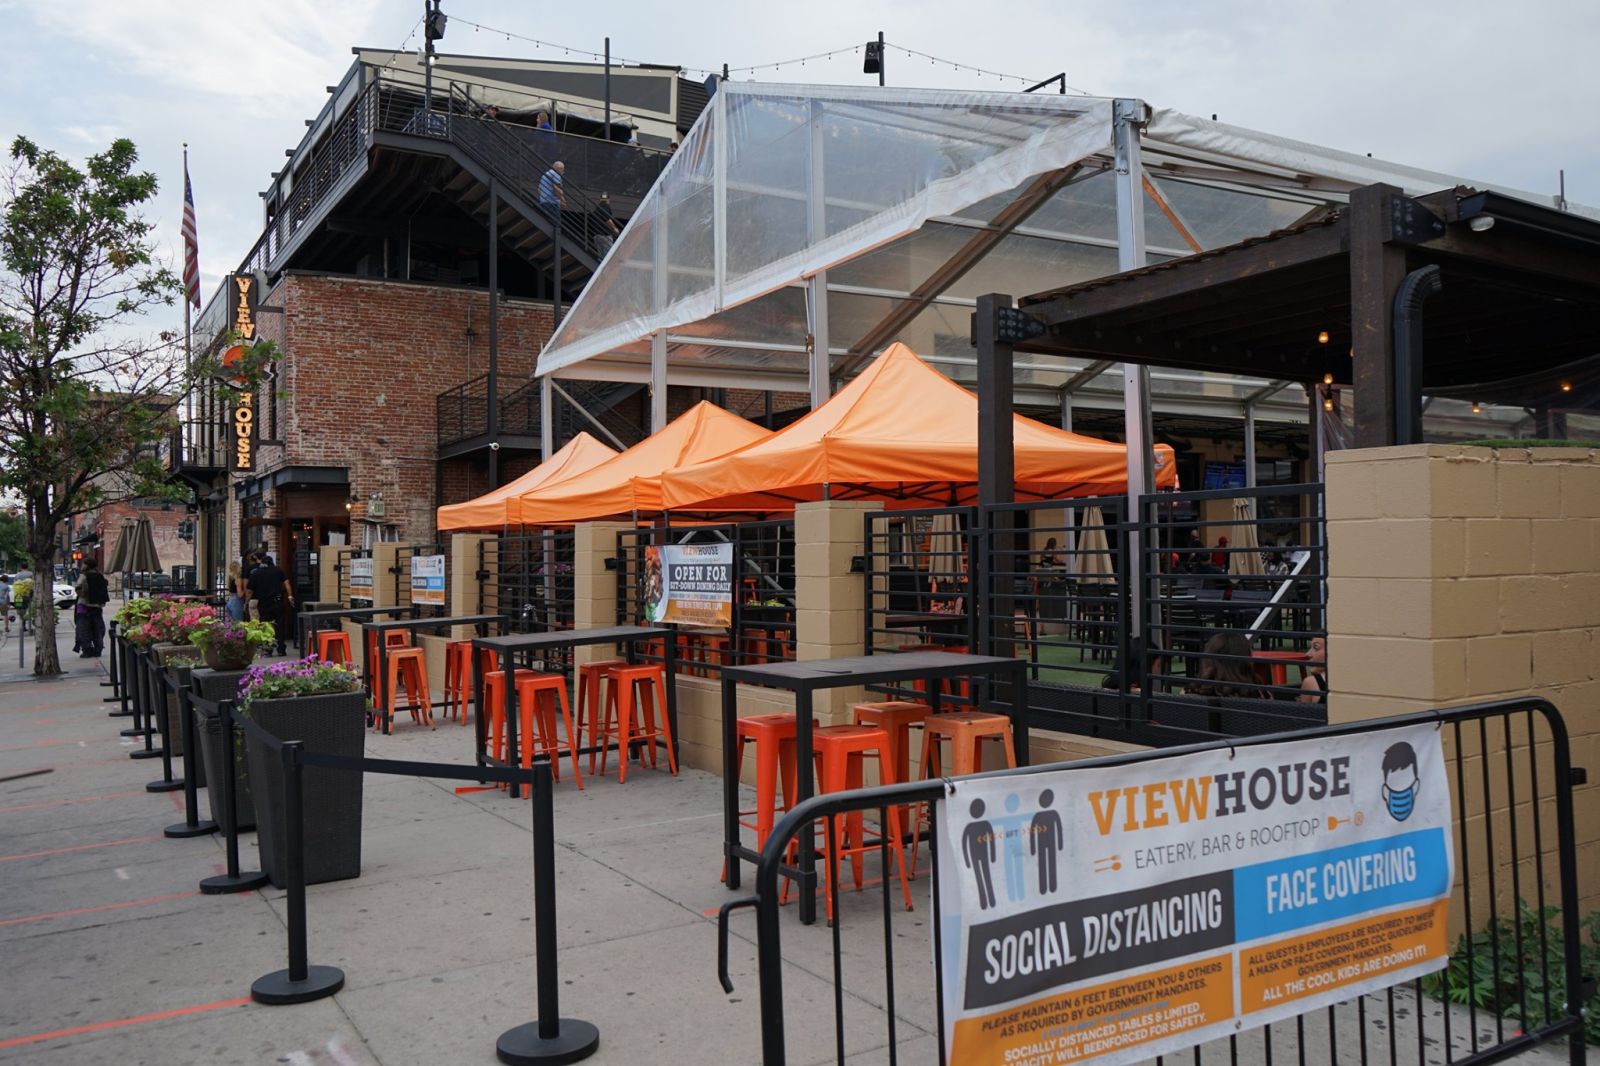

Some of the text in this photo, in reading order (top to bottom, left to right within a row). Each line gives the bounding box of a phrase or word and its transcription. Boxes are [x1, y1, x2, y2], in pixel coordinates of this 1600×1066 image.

[235, 277, 255, 338] VIEW
[670, 581, 731, 592] SIT-DOWN DINING DAILY
[674, 565, 727, 582] OPEN FOR
[1088, 756, 1350, 836] VIEWHOUSE
[1135, 818, 1320, 869] EATERY, BAR & ROOFTOP
[1266, 846, 1416, 914] FACE COVERING
[984, 888, 1222, 984] SOCIAL DISTANCING
[1248, 968, 1255, 977] A
[1256, 962, 1280, 976] MASK
[1281, 958, 1293, 968] OR
[1294, 952, 1314, 965] FACE
[1315, 942, 1355, 959] COVERING
[1356, 937, 1369, 947] PER
[1371, 932, 1386, 944] CDC
[1249, 954, 1264, 965] ALL
[1265, 946, 1298, 961] GUESTS
[1299, 944, 1305, 952] &
[1307, 931, 1350, 950] EMPLOYEES
[1352, 927, 1365, 938] ARE
[1366, 918, 1402, 934] REQUIRED
[1404, 915, 1415, 924] TO
[1263, 944, 1427, 1002] ALL THE COOL KIDS ARE DOING IT!
[1298, 955, 1351, 976] GOVERNMENT
[982, 962, 1223, 1032] PLEASE MAINTAIN 6 FEET BETWEEN YOU & OTHERS
[1000, 1027, 1015, 1039] AS
[1017, 1013, 1070, 1034] REQUIRED
[1071, 1009, 1084, 1022] BY
[1087, 992, 1154, 1017] GOVERNMENT
[1004, 1039, 1058, 1062] SOCIALLY
[1059, 1024, 1117, 1047] DISTANCED
[1119, 1014, 1154, 1031] TABLES
[1155, 1011, 1161, 1021] &
[1163, 1002, 1200, 1019] LIMITED
[1056, 1046, 1081, 1062] WILL
[1149, 1023, 1169, 1037] FOR
[1170, 1013, 1207, 1031] SAFETY.
